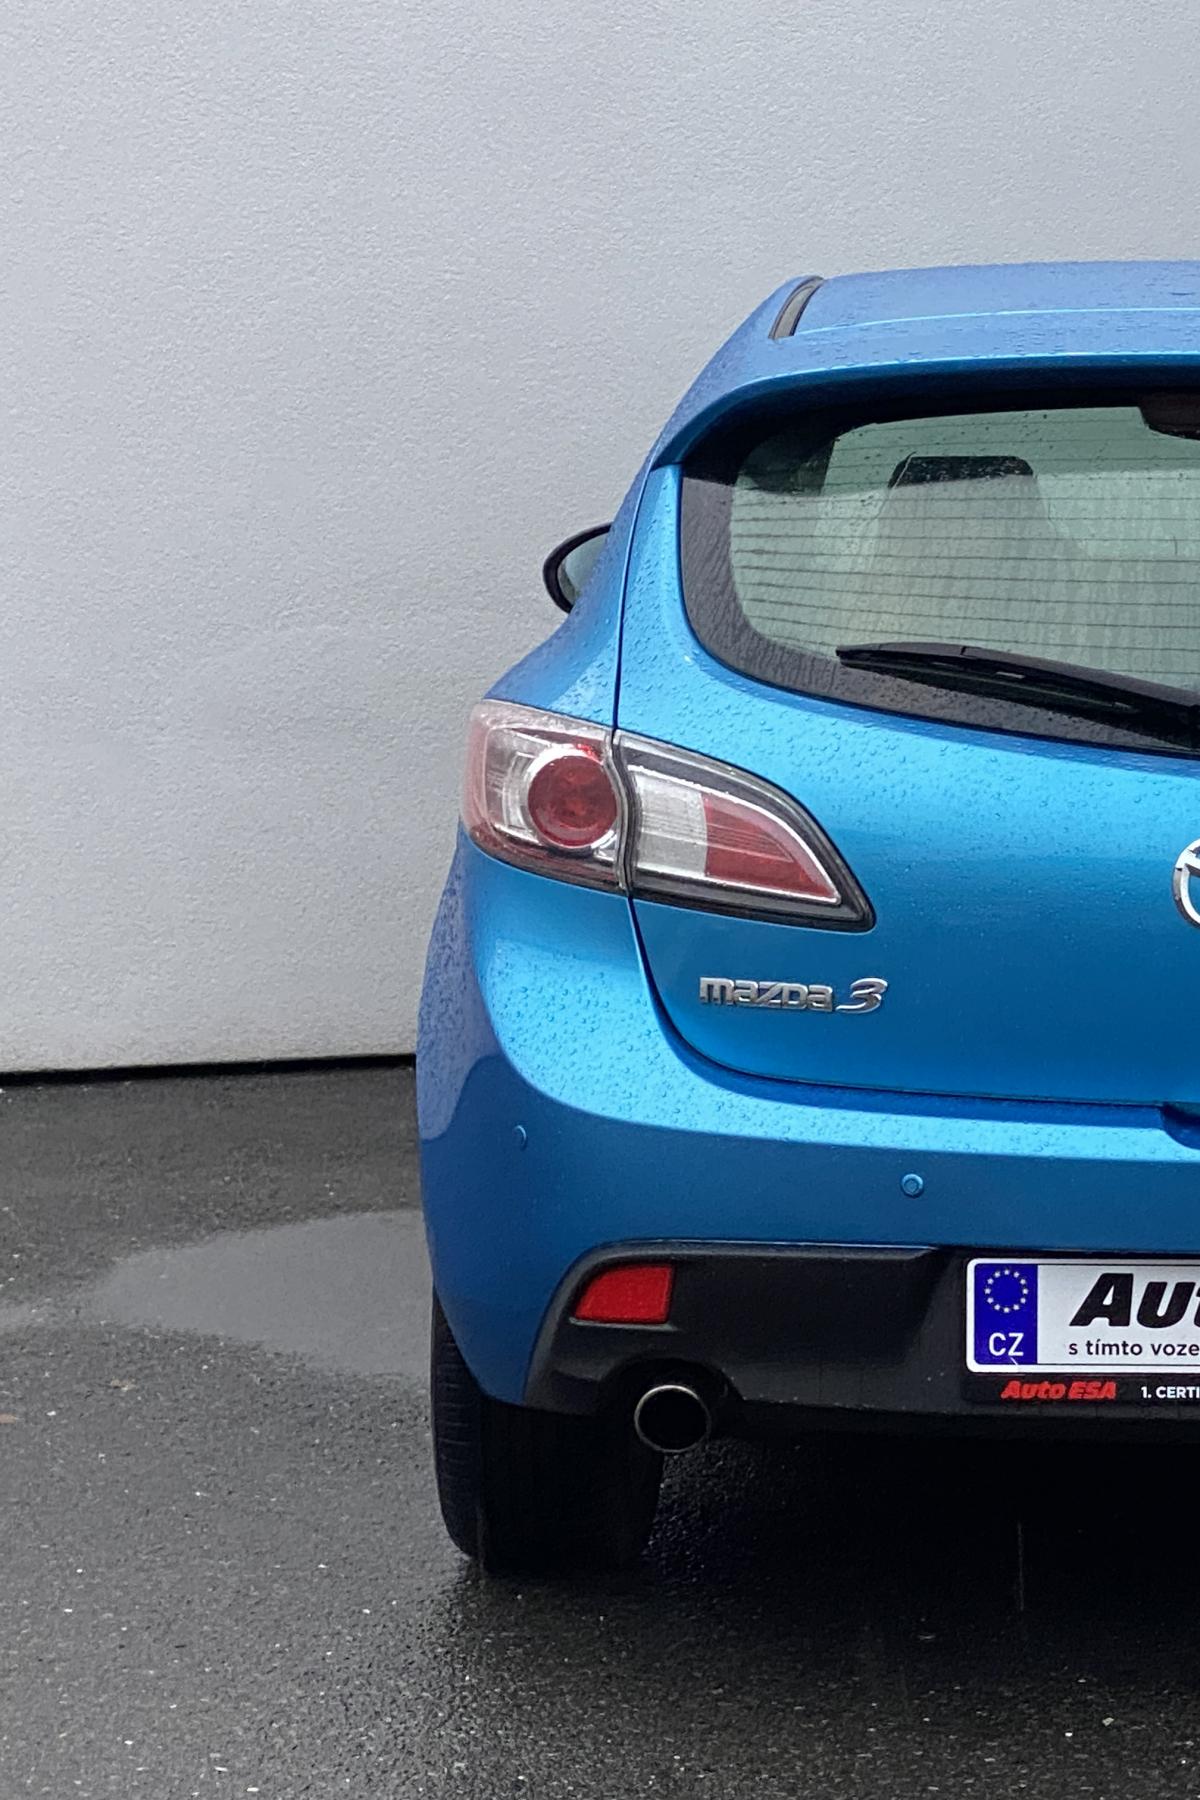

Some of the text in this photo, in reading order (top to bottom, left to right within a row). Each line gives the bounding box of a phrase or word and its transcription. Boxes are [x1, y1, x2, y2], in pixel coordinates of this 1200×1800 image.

[835, 978, 888, 1014] 3
[989, 1332, 1024, 1358] CZ
[1068, 1343, 1079, 1357] s
[1086, 1339, 1143, 1358] tímto
[1001, 1380, 1117, 1400] Auto ESA
[1141, 1385, 1153, 1399] 1.
